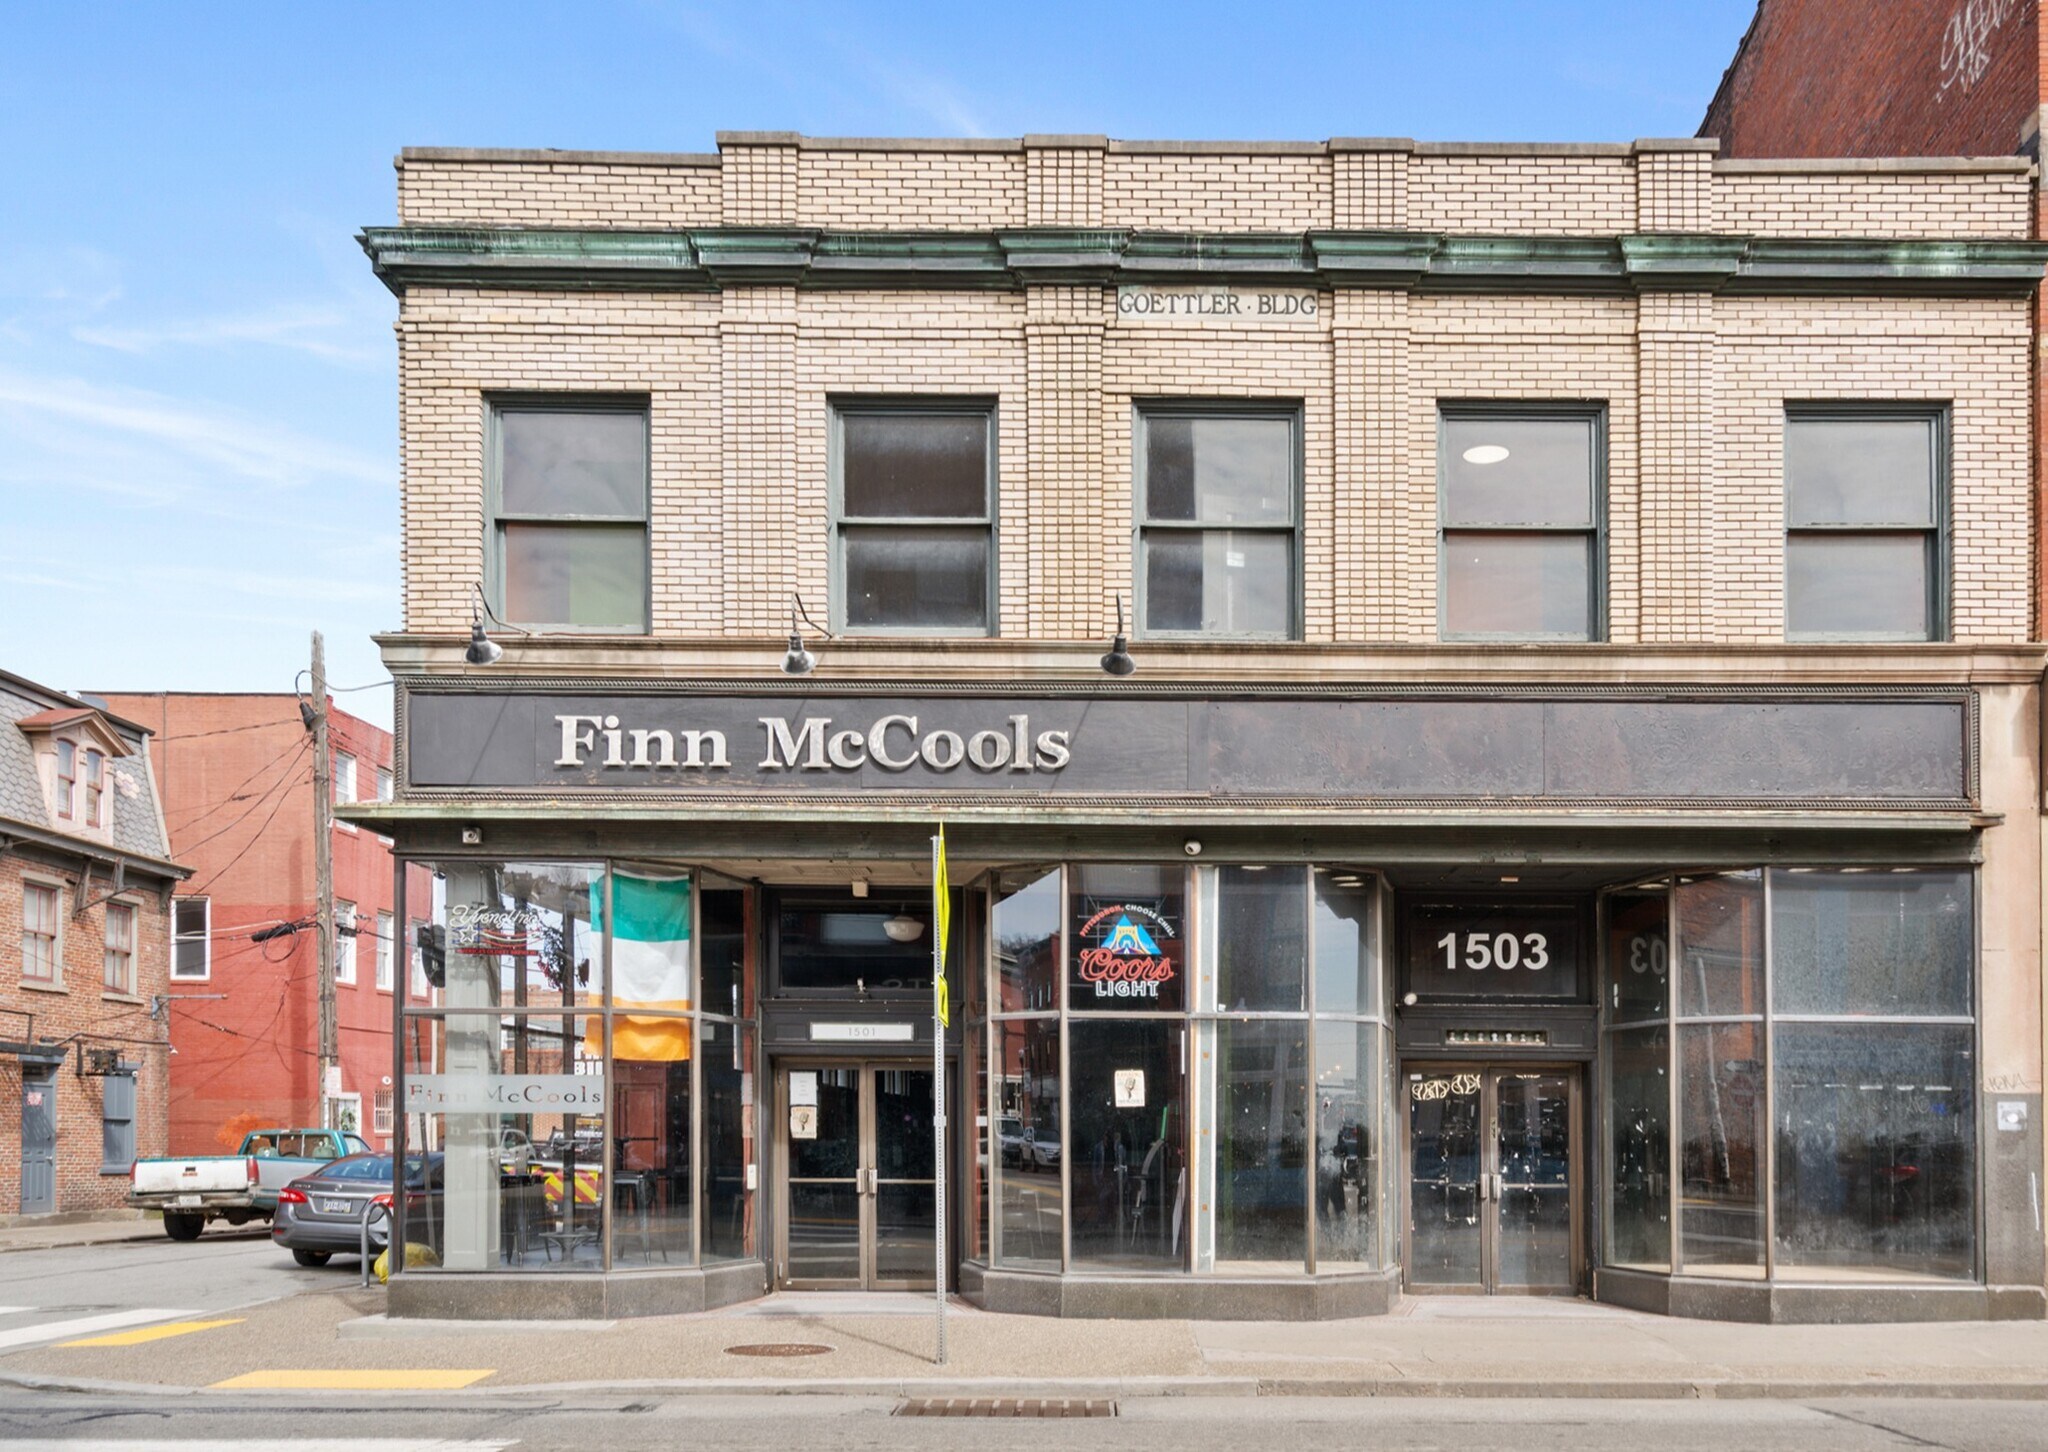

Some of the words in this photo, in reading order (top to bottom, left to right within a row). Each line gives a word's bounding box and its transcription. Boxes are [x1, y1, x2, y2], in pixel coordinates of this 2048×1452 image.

[1119, 292, 1243, 315] GOETTLER
[1257, 294, 1317, 315] BLDG
[554, 714, 731, 768] Finn
[757, 713, 1071, 769] McCools
[1125, 904, 1158, 919] CHOOSE
[1436, 932, 1549, 970] 1503
[1080, 948, 1174, 981] Coors
[1095, 980, 1159, 997] LIGHT
[848, 1026, 876, 1037] 1501
[408, 1084, 468, 1103] Finn
[486, 1084, 601, 1103] McCools
